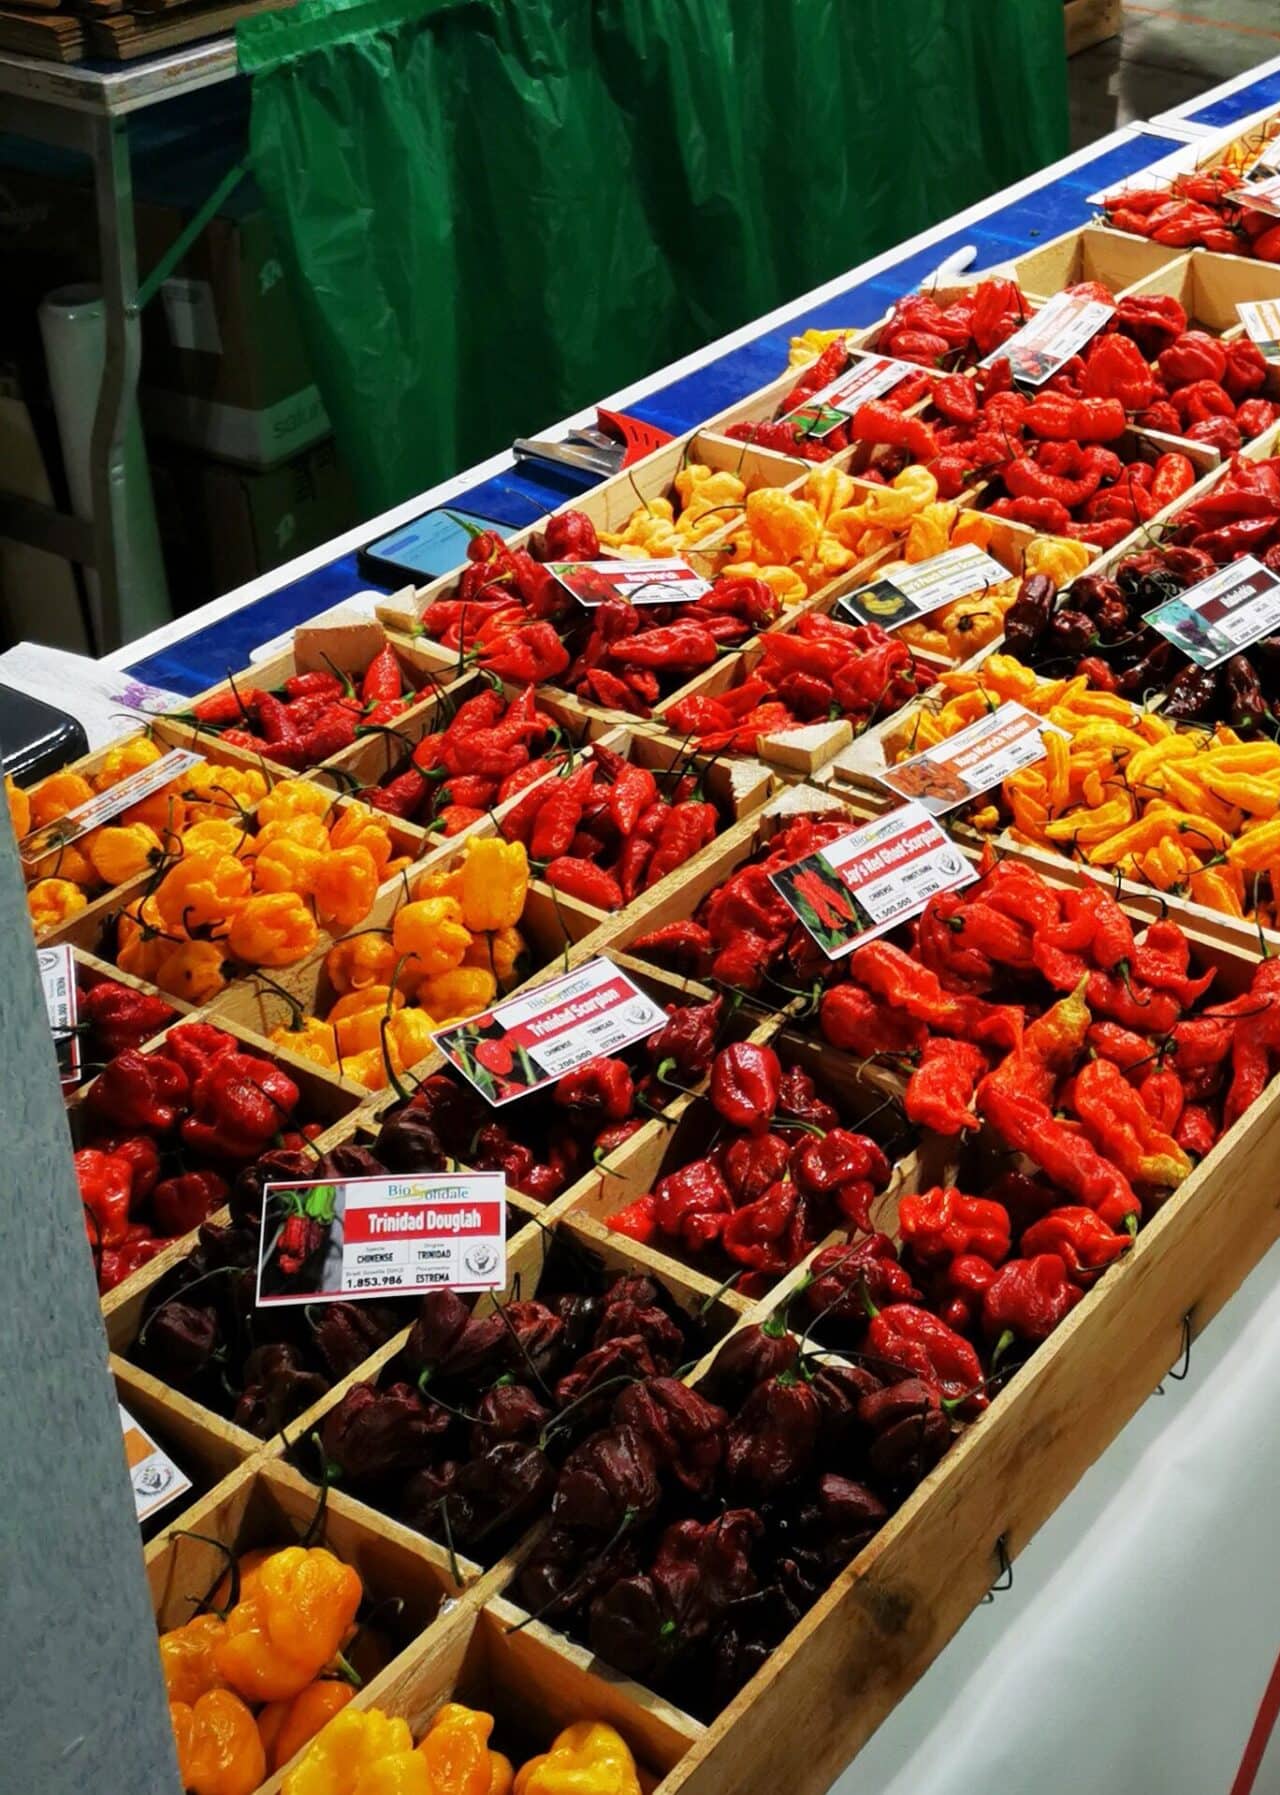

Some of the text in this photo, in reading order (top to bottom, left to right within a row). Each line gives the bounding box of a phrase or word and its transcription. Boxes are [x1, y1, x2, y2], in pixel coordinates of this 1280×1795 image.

[526, 988, 621, 1038] Trinidad Scorpion
[368, 1207, 482, 1234] Trinidad Douglah
[357, 1252, 394, 1264] CHINENSE
[417, 1249, 452, 1260] TRINIDAD
[347, 1275, 403, 1289] 1.853.986
[416, 1273, 450, 1284] ESTREMA
